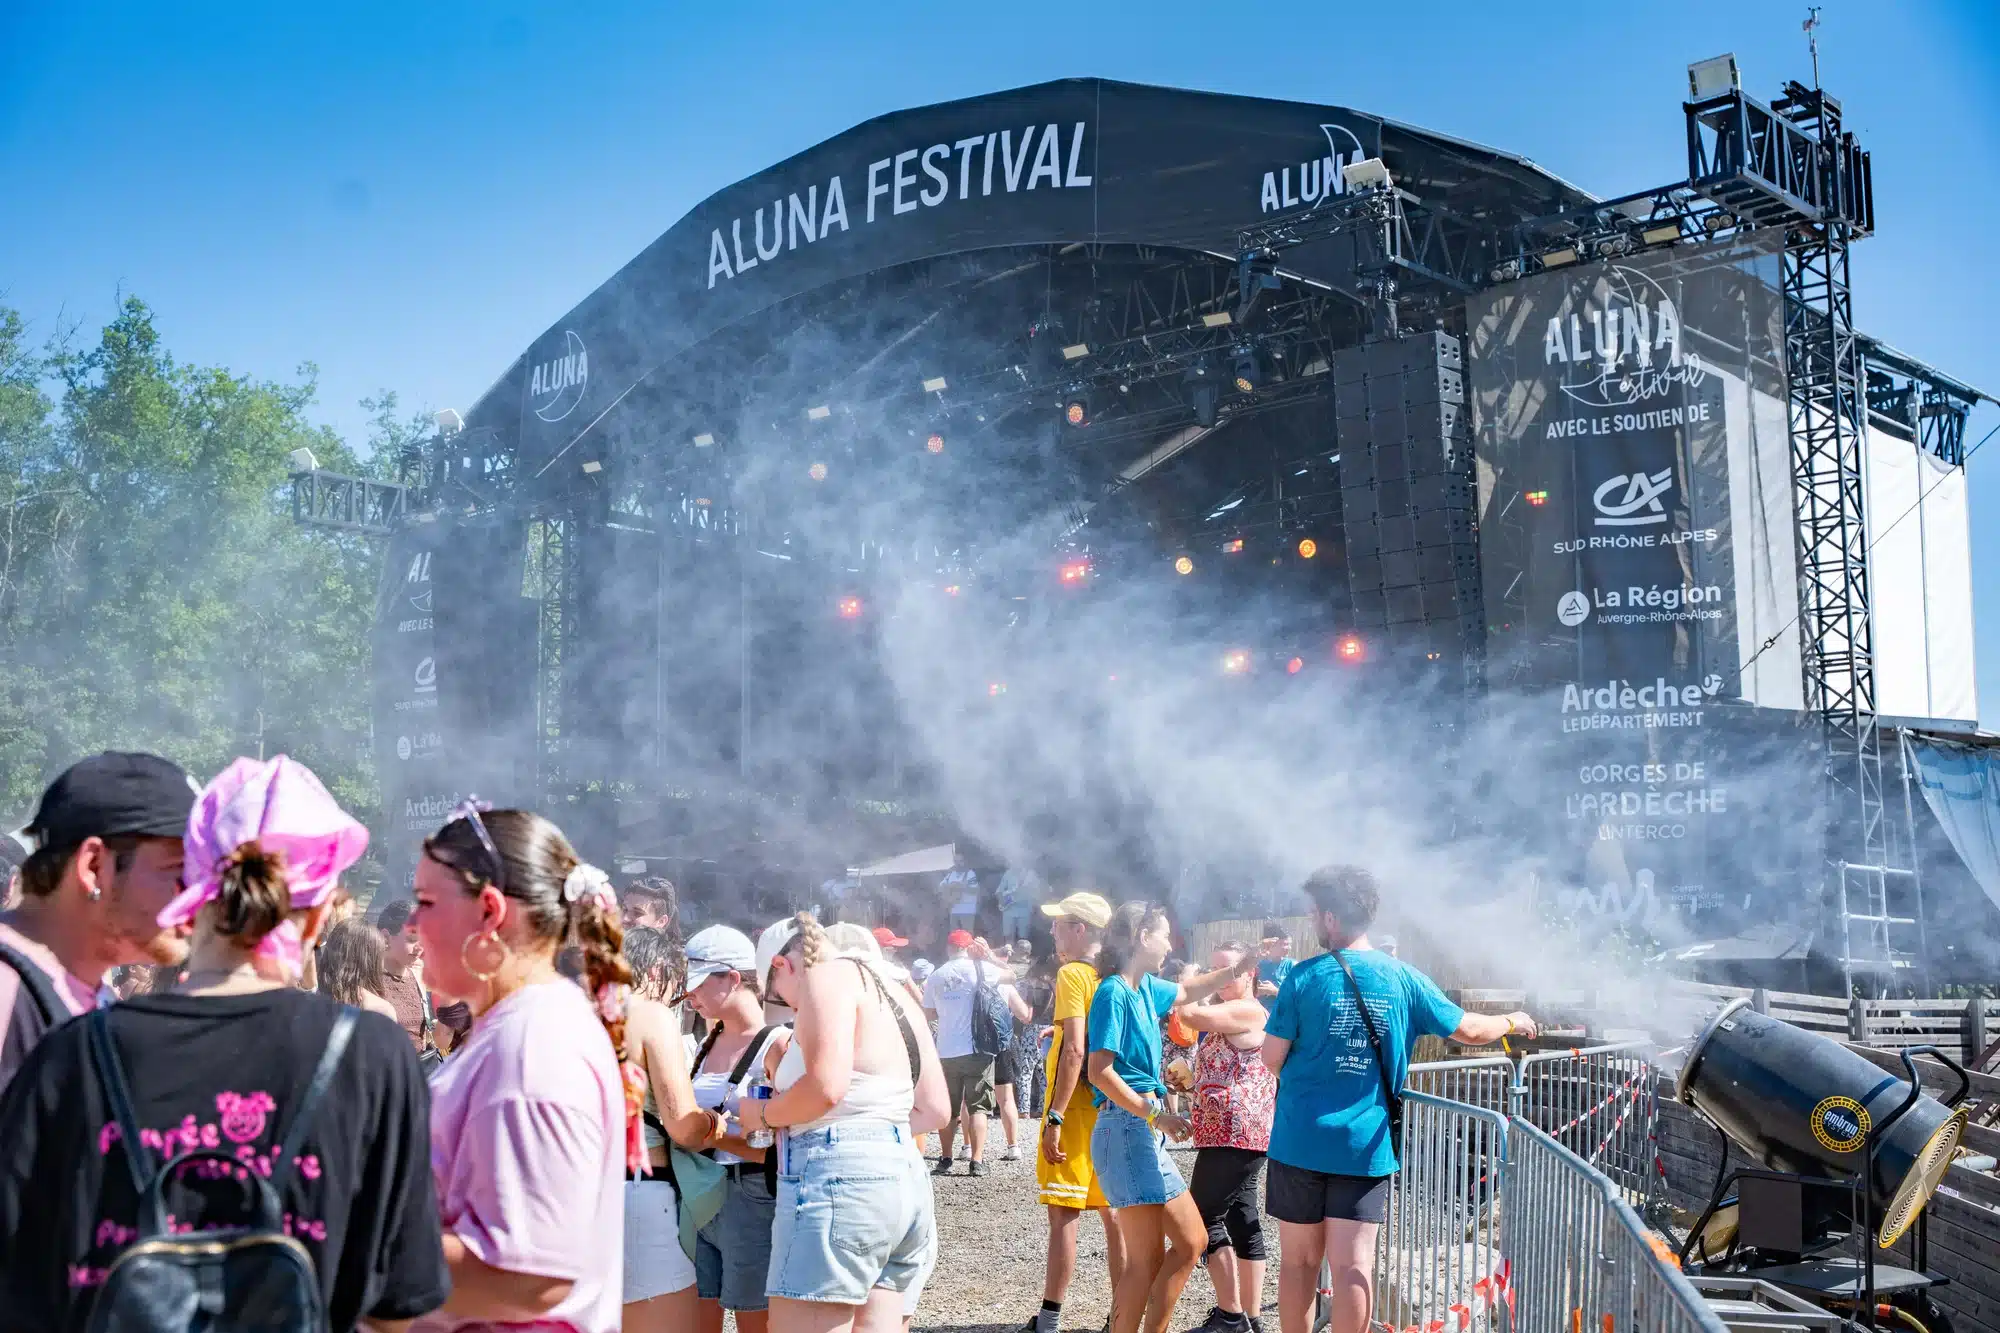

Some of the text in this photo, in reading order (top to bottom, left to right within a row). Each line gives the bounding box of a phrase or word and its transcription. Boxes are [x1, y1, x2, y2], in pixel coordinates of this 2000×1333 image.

[707, 122, 1092, 290] ALUNA FESTIVAL
[1545, 299, 1682, 367] ALUNA
[531, 352, 588, 397] ALUNA
[1599, 352, 1705, 404] Festival
[1546, 403, 1710, 439] AVEC LE SOUTIEN DE
[1554, 528, 1718, 554] SUD RHÔNE ALPES
[1594, 583, 1722, 611] La Région
[397, 620, 417, 632] AVEC
[1597, 609, 1722, 625] Auvergne-Rhône-Alpes
[1561, 677, 1702, 714] Ardèche
[1579, 761, 1706, 785] GORGES DE
[1566, 784, 1728, 819] L'ARDÈCHE
[1824, 1110, 1859, 1136] embrun
